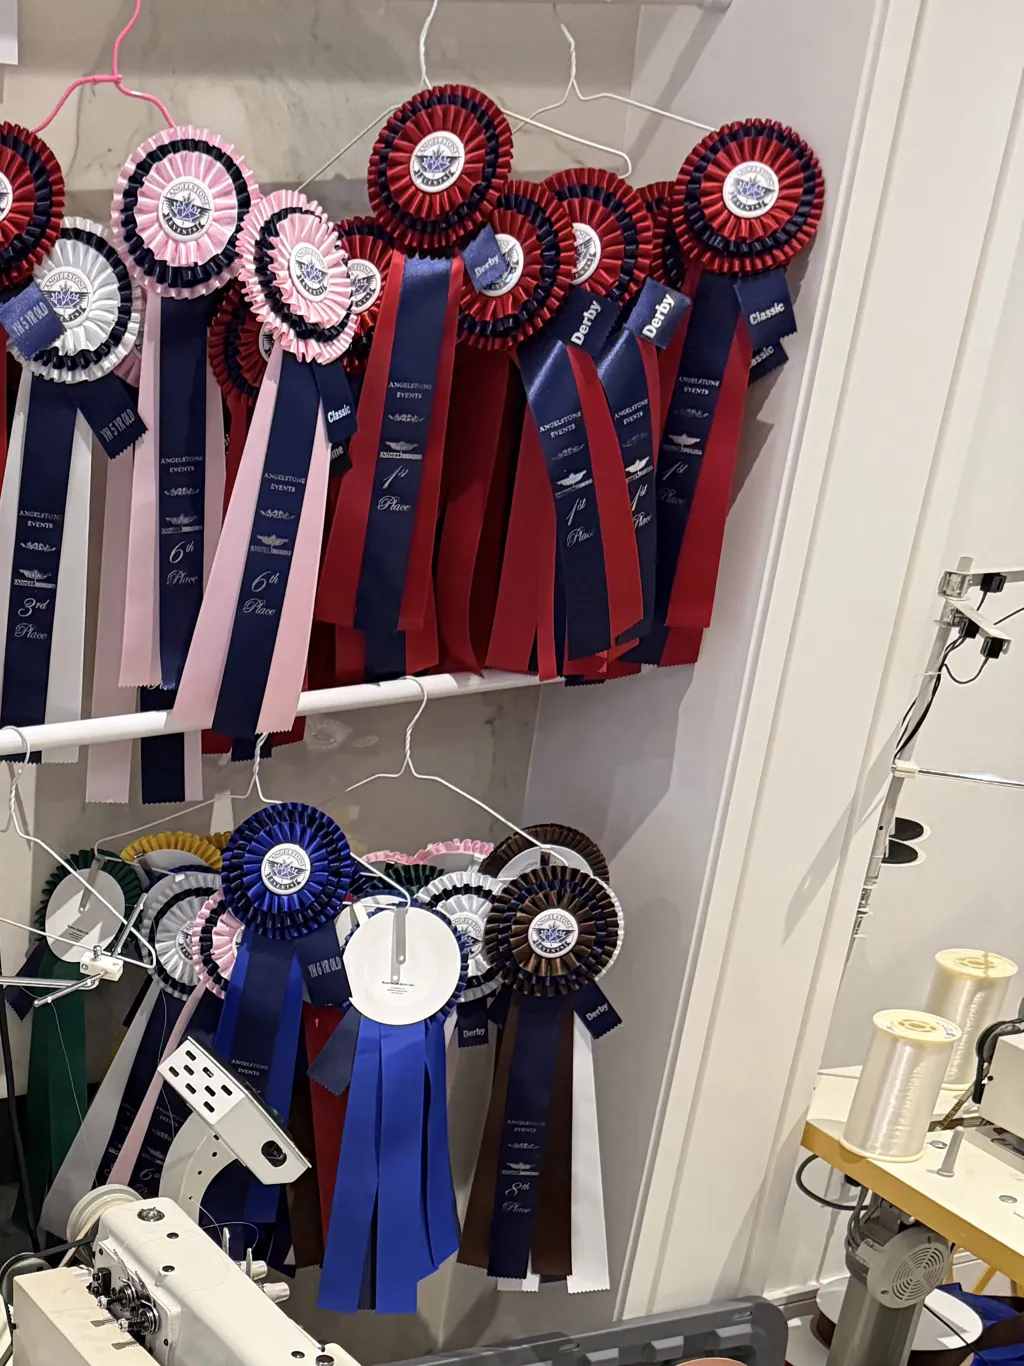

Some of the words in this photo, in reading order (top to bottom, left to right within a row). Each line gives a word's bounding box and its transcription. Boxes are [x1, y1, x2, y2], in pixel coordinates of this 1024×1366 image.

[419, 137, 460, 155] ANGELSTONE
[421, 174, 450, 187] EVENTS
[168, 183, 210, 207] ANGELSTONE
[169, 221, 198, 235] EVENTS
[474, 254, 499, 278] Derby
[44, 272, 89, 291] ANGELSTONE
[11, 322, 23, 337] YH
[20, 318, 30, 332] 5
[26, 311, 37, 327] YR
[34, 301, 49, 320] OLD
[570, 300, 602, 346] Derby
[642, 293, 675, 339] Derby
[749, 302, 785, 326] Classic
[750, 344, 775, 367] assic
[388, 381, 432, 391] ANGELSTONE
[678, 375, 720, 387] ANGELSTONE
[396, 391, 422, 400] EVENTS
[684, 386, 709, 396] EVENTS
[327, 404, 351, 424] Classic
[614, 398, 649, 420] ANGELSTONE
[623, 410, 644, 426] EVENTS
[100, 428, 111, 443] YH
[108, 421, 118, 437] 5
[114, 415, 125, 431] YR
[122, 408, 136, 427] OLD
[539, 411, 582, 433] ANGELSTONE
[550, 423, 576, 439] EVENTS
[161, 455, 204, 465] ANGELSTONE
[169, 465, 195, 473] EVENTS
[264, 473, 307, 485] ANGELSTONE
[382, 465, 410, 490] 1st
[662, 461, 689, 481] 1st
[271, 483, 296, 493] EVENTS
[377, 495, 412, 513] Place
[630, 483, 649, 512] 1st
[19, 510, 64, 522] ANGELSTONE
[566, 497, 587, 527] 1st
[27, 519, 54, 529] EVENTS
[169, 541, 195, 564] 6th
[166, 569, 199, 585] Place
[251, 571, 280, 593] 6th
[18, 598, 48, 618] 3rd
[242, 598, 277, 616] Place
[14, 623, 48, 641] Place
[271, 848, 305, 868] ANGELSTONE
[537, 914, 574, 929] ANGELSTONE
[537, 944, 566, 954] EVENTS
[308, 963, 318, 978] YH
[321, 959, 330, 975] YR
[330, 956, 342, 972] OLD
[586, 1002, 609, 1022] Derby
[462, 1027, 486, 1039] Derby
[231, 1059, 268, 1071] ANGELSTONE
[237, 1067, 260, 1077] EVENTS
[505, 1181, 531, 1197] 8th
[501, 1201, 532, 1213] Place
